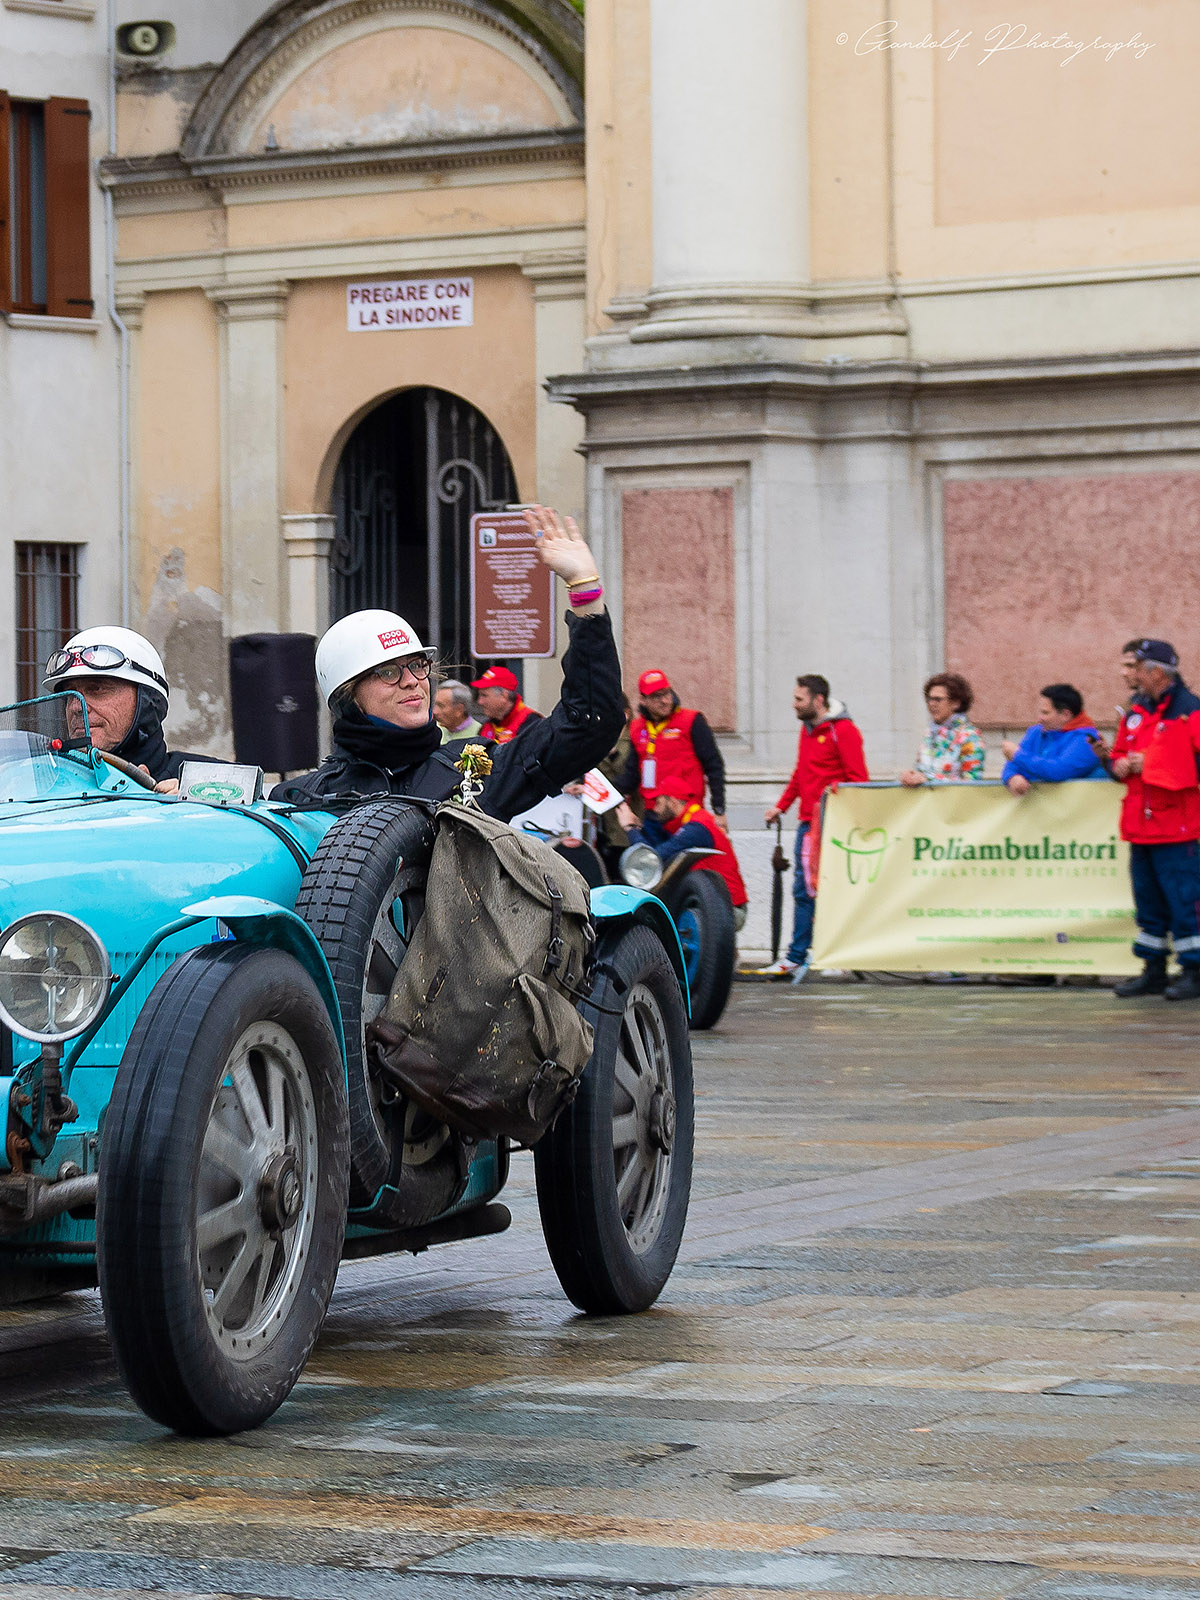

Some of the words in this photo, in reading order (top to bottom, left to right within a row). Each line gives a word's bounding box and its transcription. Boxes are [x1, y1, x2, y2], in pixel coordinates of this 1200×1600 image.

[350, 285, 429, 304] PREGARE
[434, 282, 470, 299] CON
[359, 310, 379, 326] LA
[385, 305, 462, 324] SINDONE
[381, 630, 402, 641] 1000
[383, 636, 407, 648] MIGLIA
[913, 835, 1117, 861] Poliambulatori
